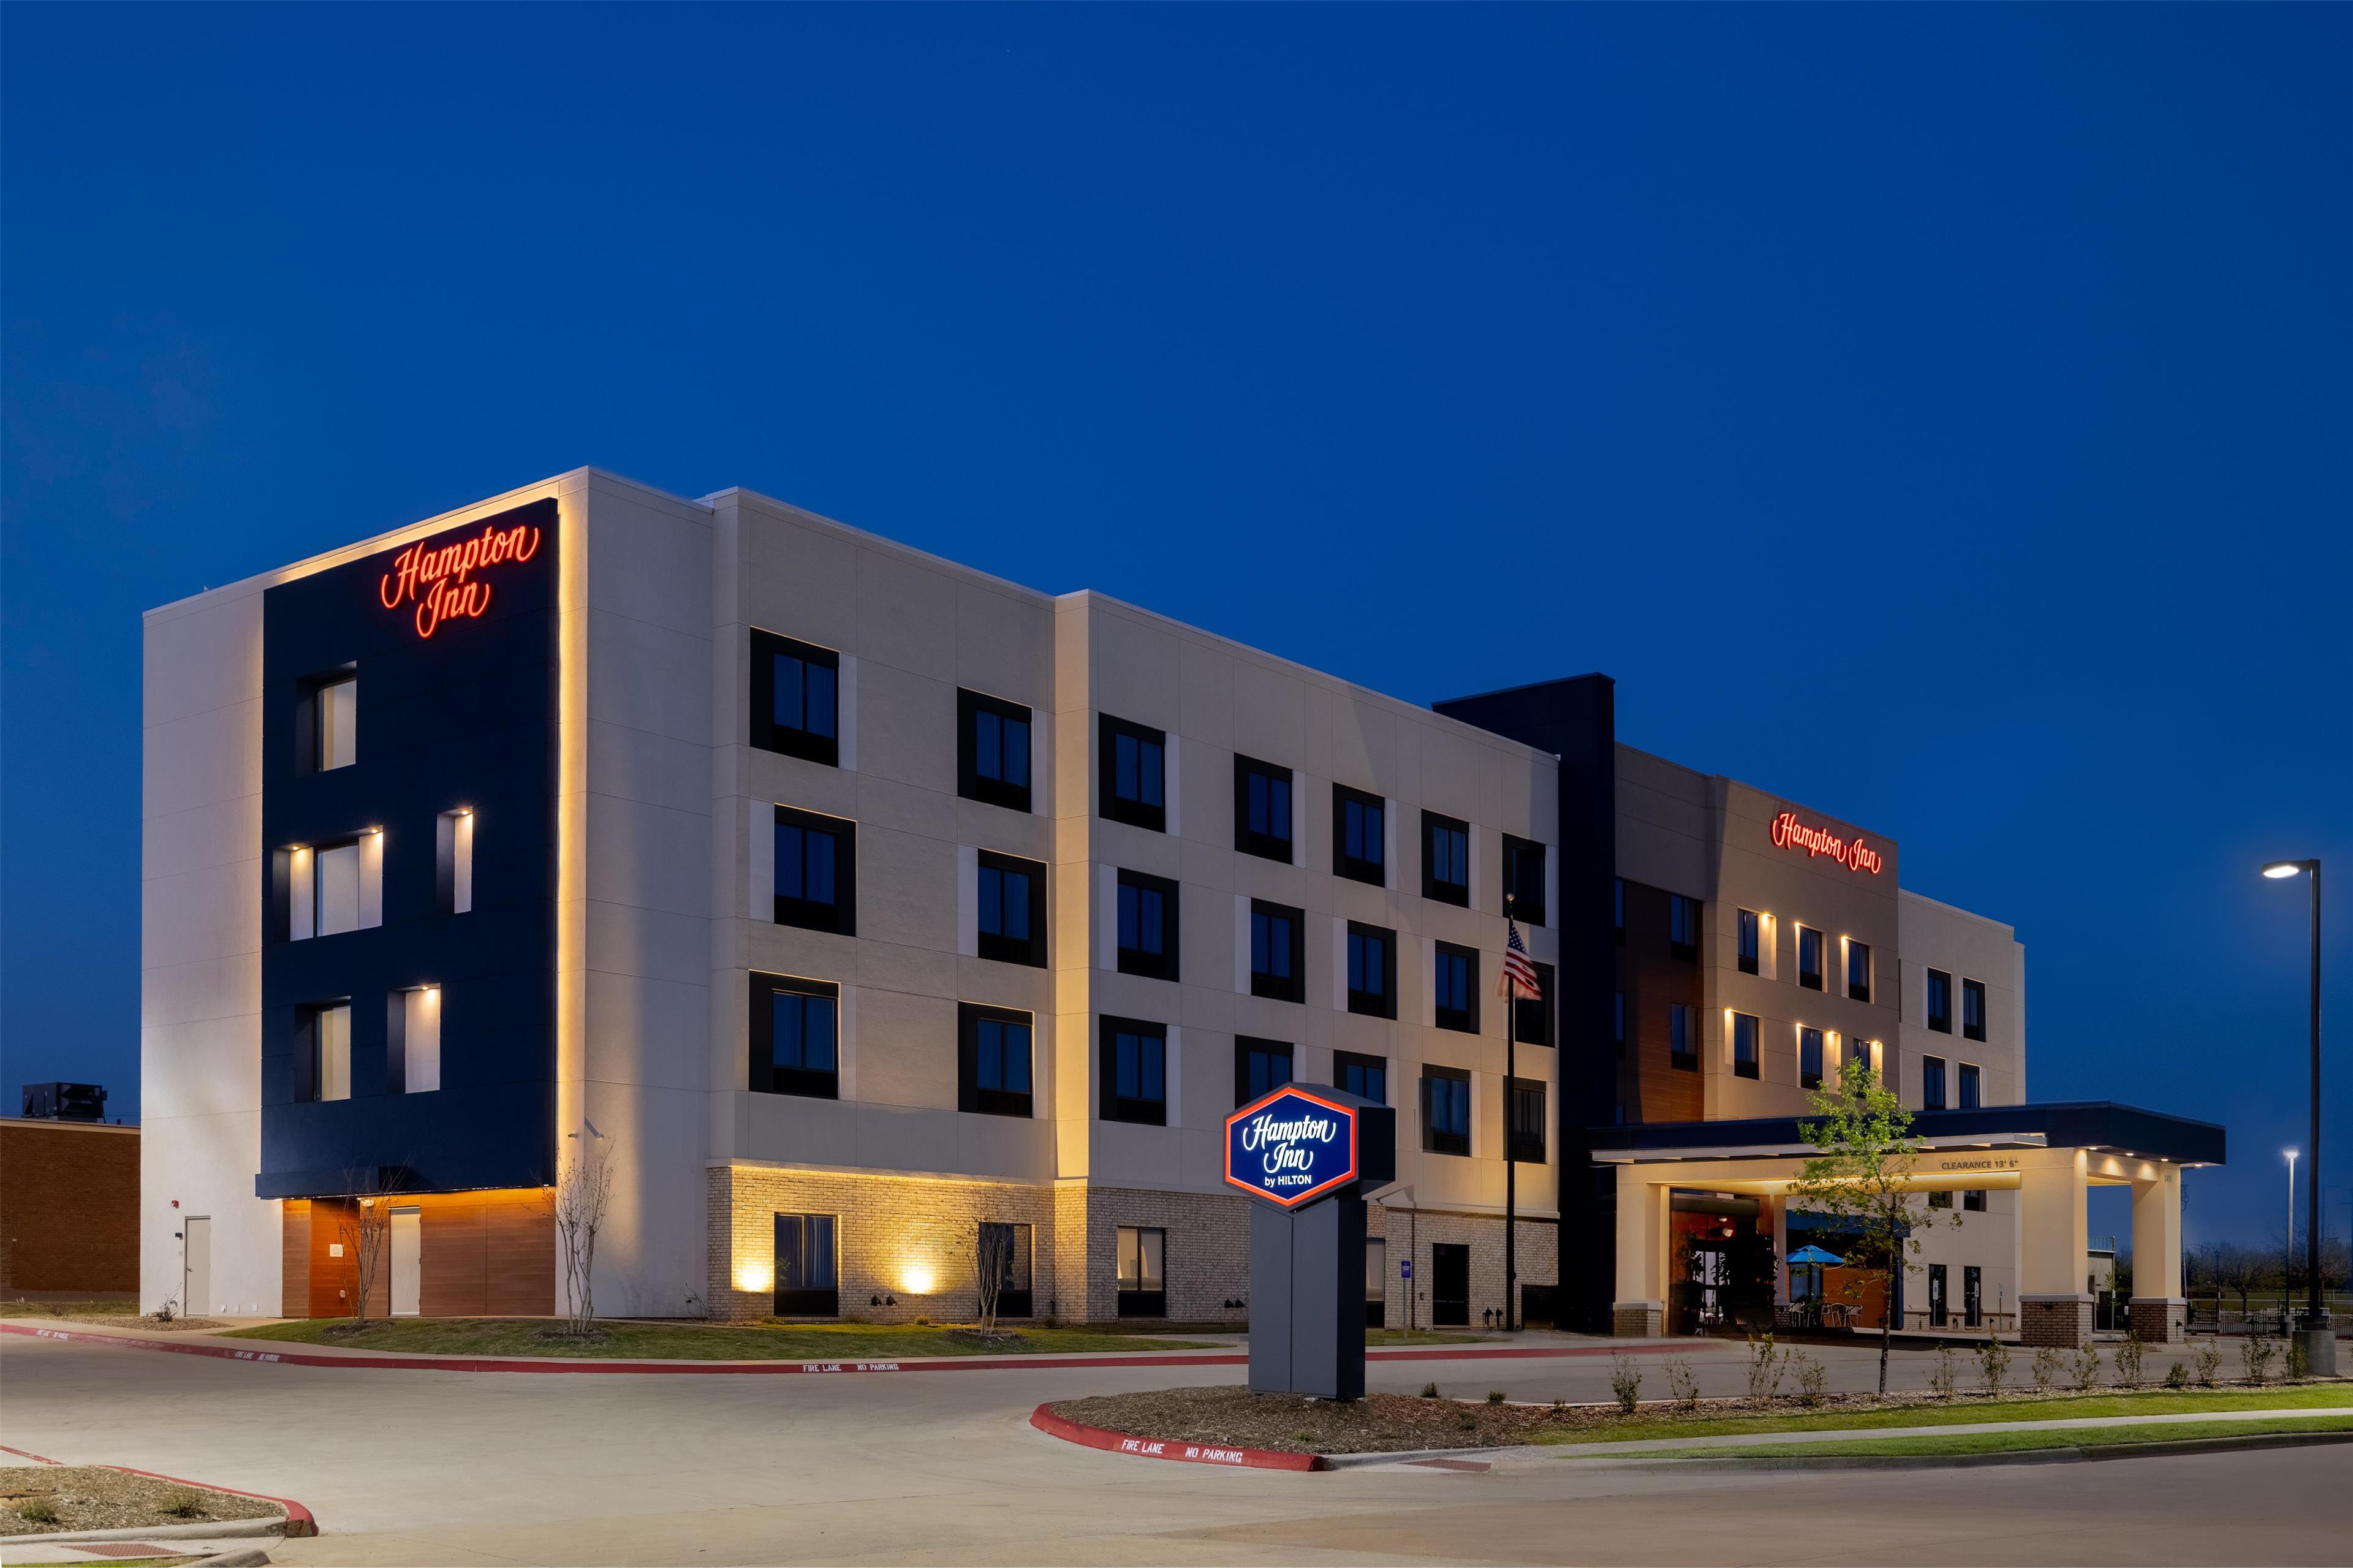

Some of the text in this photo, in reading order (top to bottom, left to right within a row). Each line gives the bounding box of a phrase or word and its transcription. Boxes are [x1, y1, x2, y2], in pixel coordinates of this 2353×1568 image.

[381, 525, 539, 608] Hampton
[416, 577, 490, 638] Inn
[1771, 812, 1881, 874] Hampton Inn
[1243, 1113, 1336, 1151] Hampton
[1263, 1142, 1314, 1174] Inn
[1941, 1161, 1992, 1170] CLEARANCE
[1265, 1175, 1312, 1187] by HILTON
[1121, 1439, 1243, 1463] FIRE LANE NO PARKING
